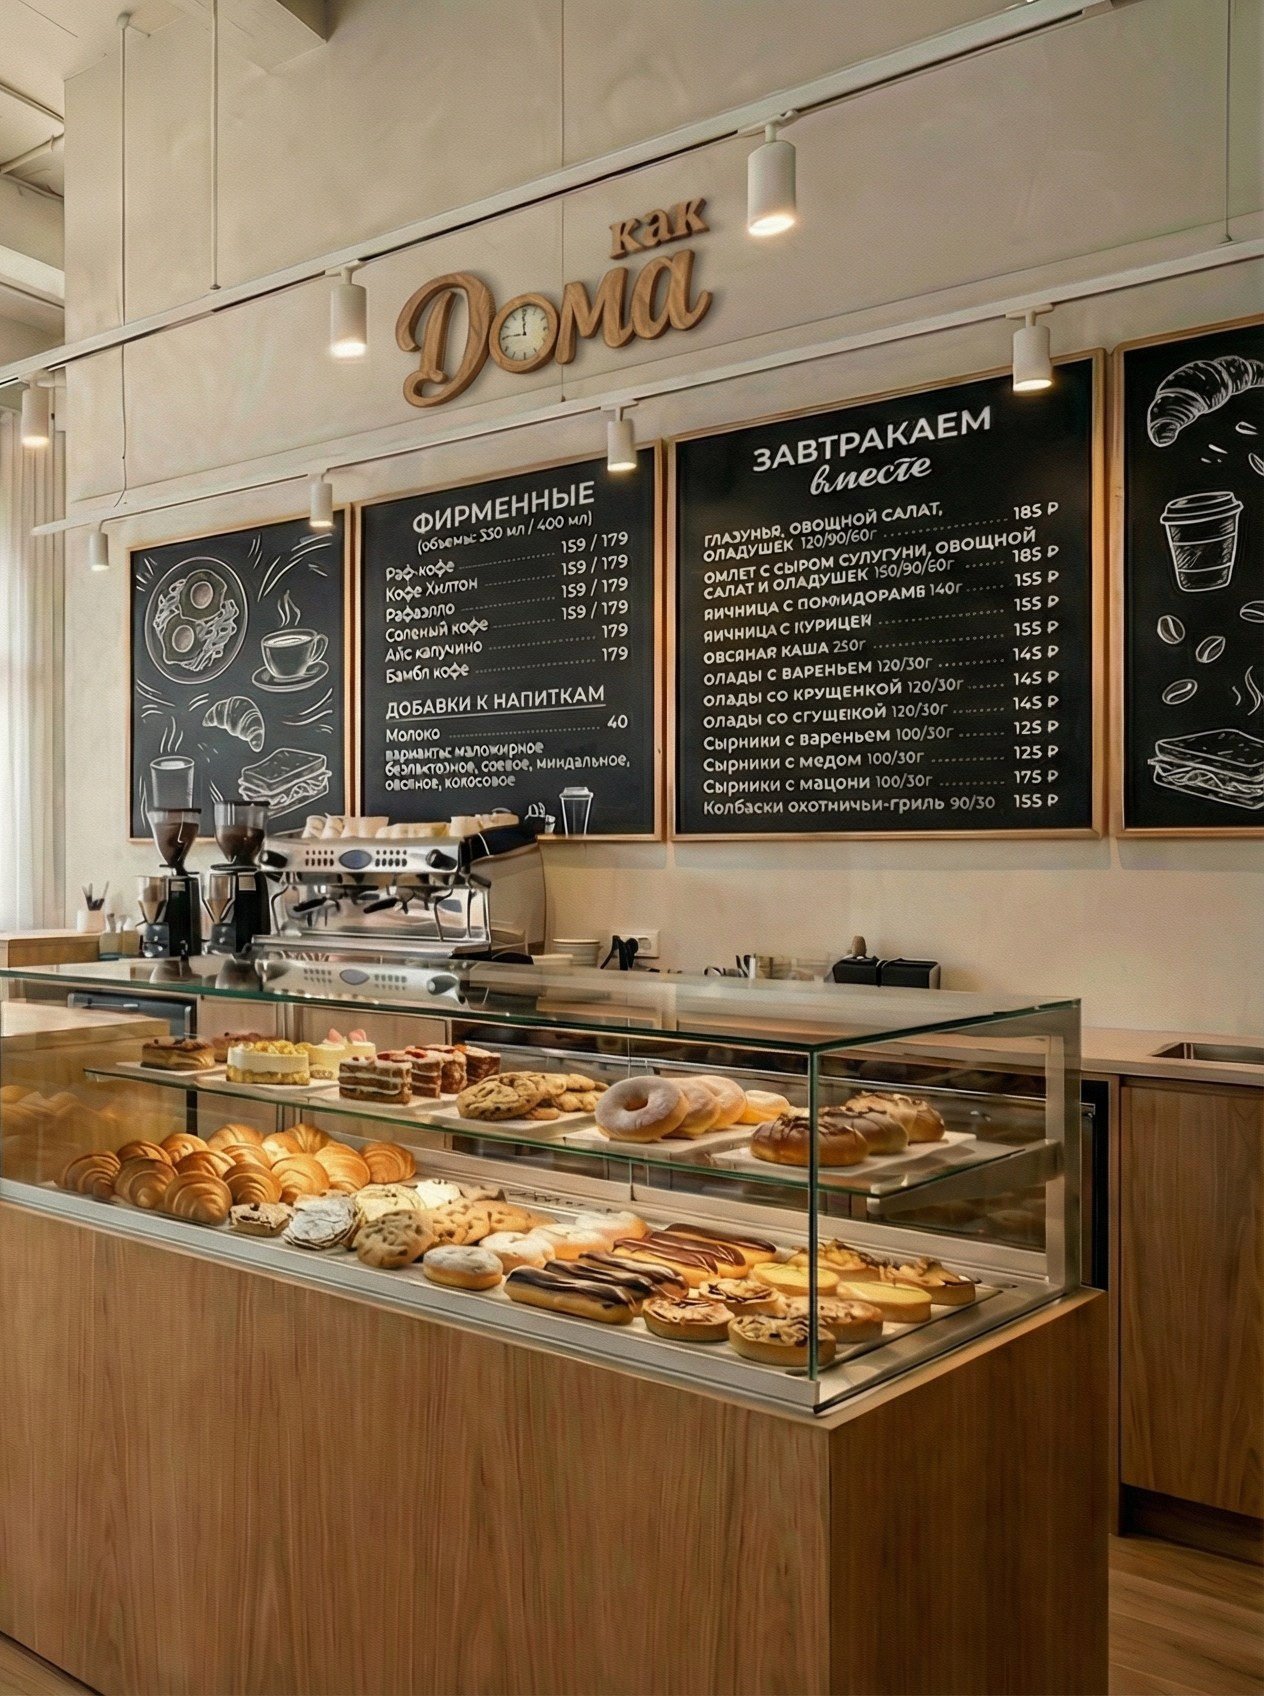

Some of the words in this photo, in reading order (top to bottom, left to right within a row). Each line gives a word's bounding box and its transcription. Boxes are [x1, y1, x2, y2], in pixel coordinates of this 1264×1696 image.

[609, 197, 710, 259] как
[753, 406, 990, 471] ЗАВТРАКАЕМ
[810, 457, 931, 495] вместе
[413, 481, 594, 536] ФИРМЕННЫЕ
[507, 525, 525, 536] мл
[537, 516, 564, 530] 400
[568, 510, 592, 526] мл)
[789, 509, 877, 535] ОВОЩНОЙ
[561, 538, 586, 553] 159
[590, 534, 597, 552] /
[602, 531, 628, 547] 179
[703, 539, 793, 562] ОЛАДУШЕК
[1014, 503, 1042, 520] 185
[562, 560, 586, 575] 159
[591, 556, 597, 574] /
[602, 554, 628, 570] 179
[704, 566, 756, 584] ОМЛЕТ
[774, 556, 834, 575] СЫРОМ
[935, 526, 1036, 554] ОВОЩНОЙ
[561, 583, 586, 598] 159
[590, 578, 598, 596] /
[602, 577, 628, 593] 179
[704, 582, 754, 599] САЛАТ
[758, 581, 768, 593] И
[773, 568, 868, 591] ОЛАДУШЕК
[1012, 547, 1041, 562] 185
[704, 602, 779, 621] ЯИЧНИЦА
[1015, 571, 1042, 586] 155
[452, 617, 488, 636] кофе
[562, 605, 586, 620] 159
[591, 601, 597, 619] /
[601, 600, 628, 615] 179
[602, 623, 628, 638] 179
[704, 625, 777, 643] ЯИЧНИЦА
[1014, 596, 1041, 611] 155
[703, 647, 777, 664] ОВСЯНАЯ
[782, 642, 829, 657] КАША
[1014, 621, 1041, 636] 155
[386, 665, 429, 683] Бамбл
[434, 662, 469, 680] кофе
[602, 646, 628, 661] 179
[782, 661, 872, 680] ВАРЕНЬЕМ
[1013, 646, 1042, 661] 145
[1014, 671, 1042, 685] 145
[386, 696, 470, 720] ДОБАВКИ
[477, 695, 488, 710] К
[494, 685, 604, 709] НАПИТКАМ
[1013, 696, 1042, 710] 145
[386, 728, 440, 742] Молоко
[607, 715, 628, 728] 40
[704, 735, 780, 753] Сырники
[785, 735, 794, 746] с
[800, 730, 890, 748] вареньем
[1014, 720, 1042, 734] 125
[703, 758, 780, 775] Сырники
[785, 757, 794, 768] с
[800, 754, 861, 769] медом
[1014, 745, 1042, 759] 125
[703, 779, 780, 797] Сырники
[785, 780, 794, 791] с
[800, 777, 870, 792] мацони
[1014, 770, 1042, 784] 175
[704, 799, 783, 815] Колбаски
[788, 798, 944, 814] охотничьи-гриль
[950, 795, 995, 810] 90/30
[1014, 794, 1042, 808] 155
